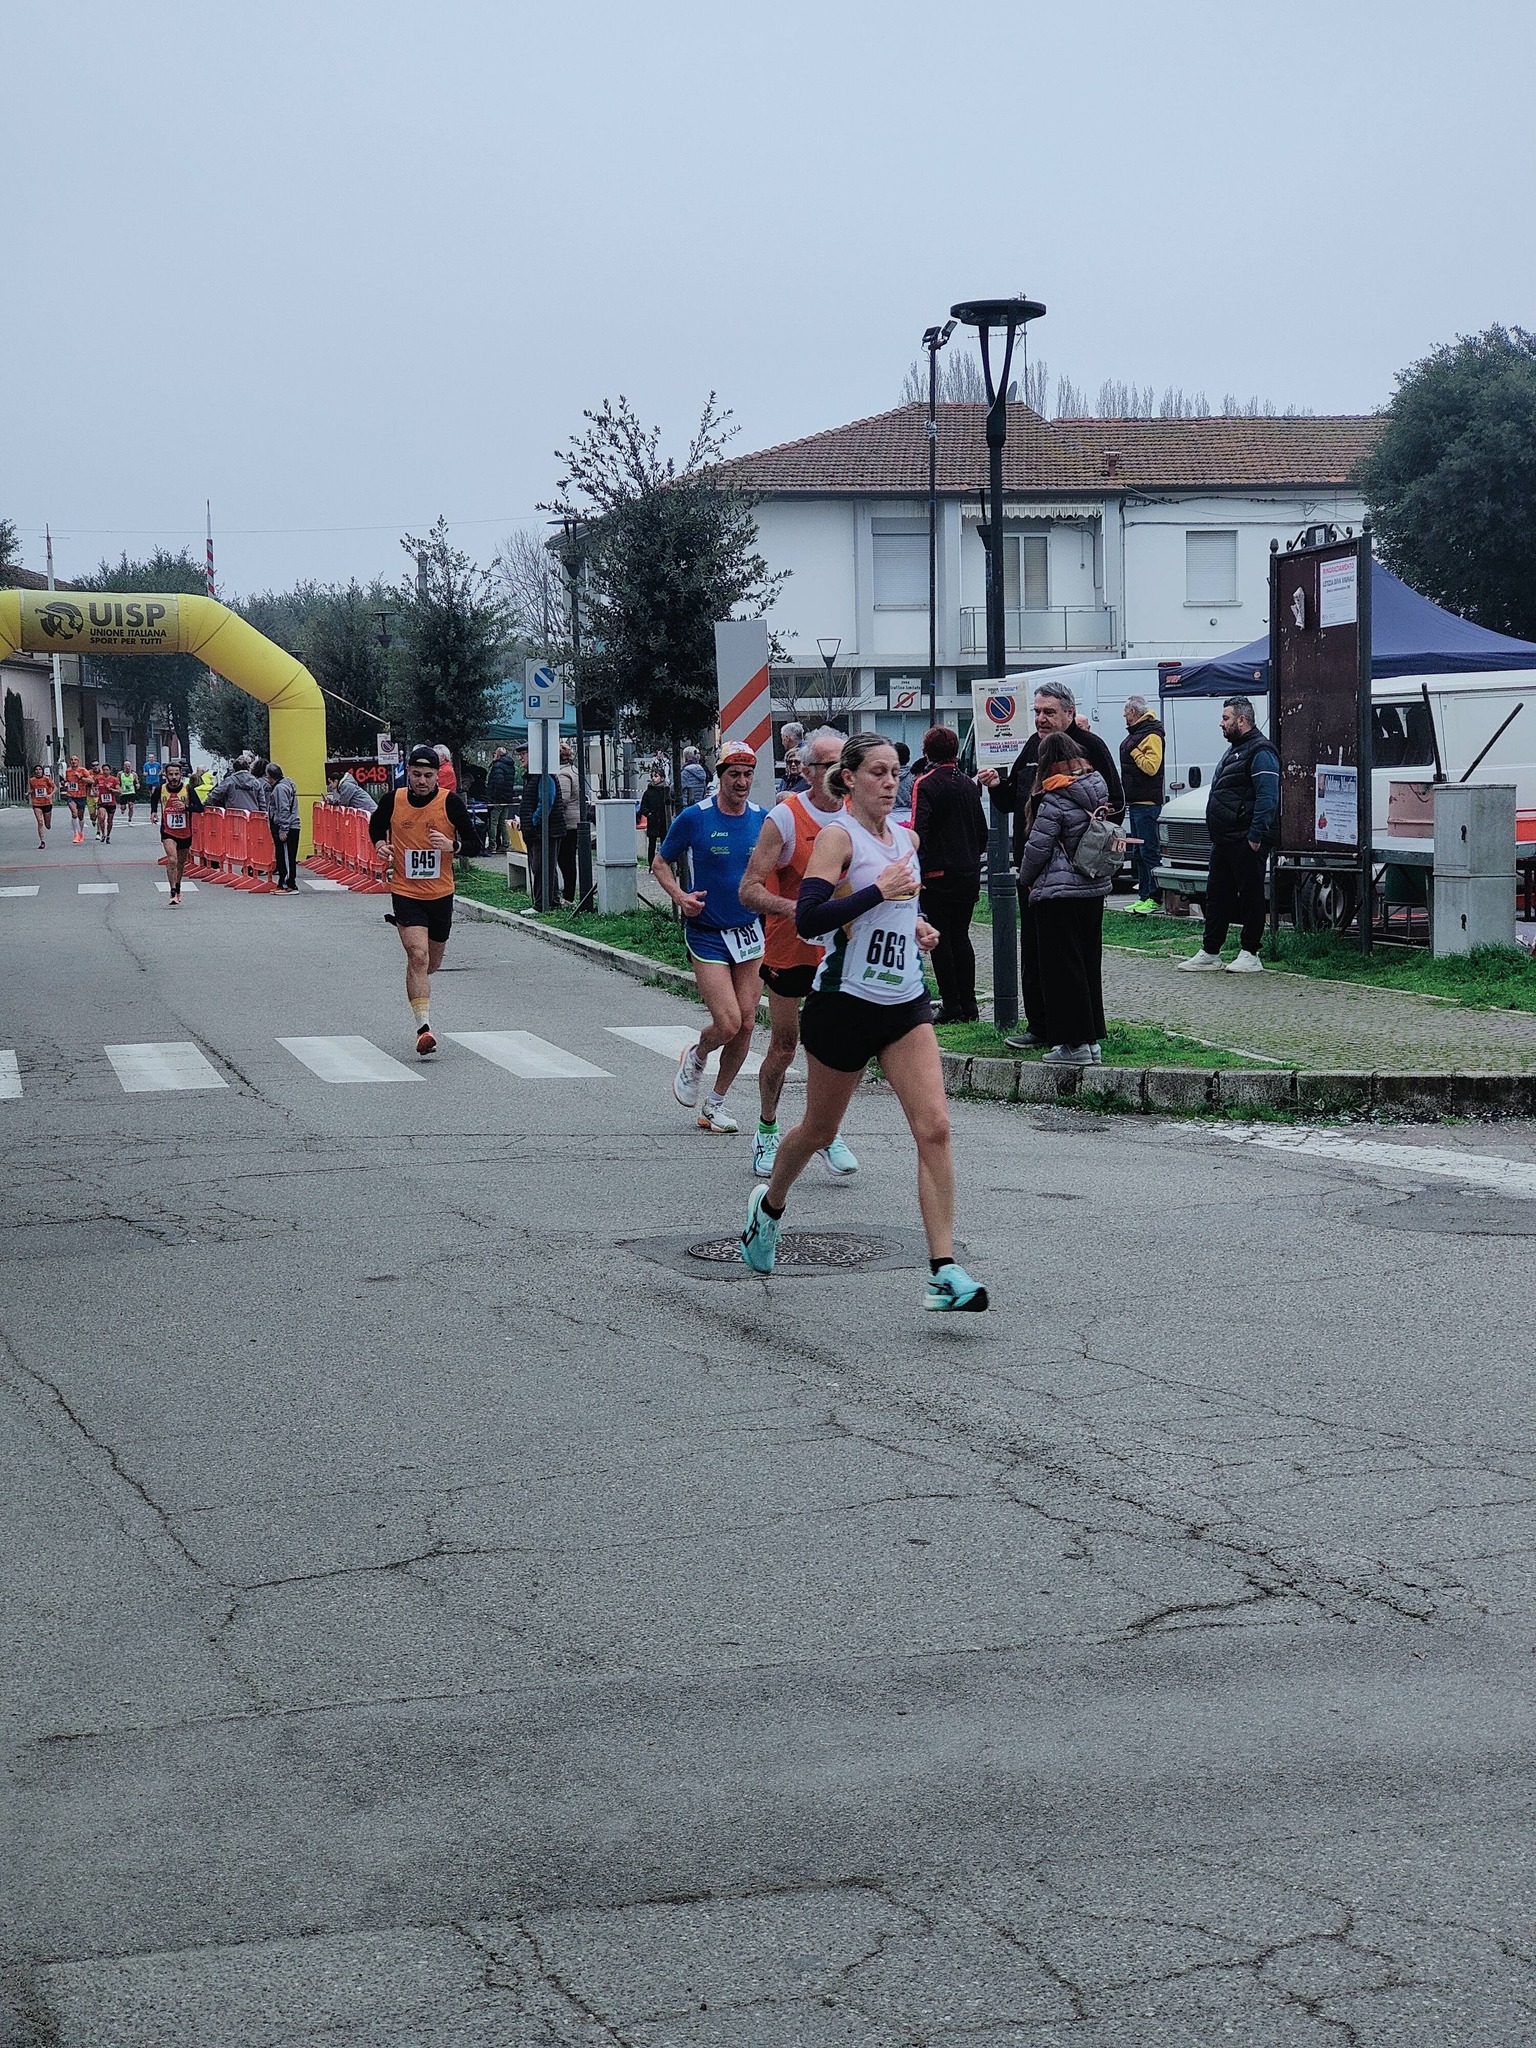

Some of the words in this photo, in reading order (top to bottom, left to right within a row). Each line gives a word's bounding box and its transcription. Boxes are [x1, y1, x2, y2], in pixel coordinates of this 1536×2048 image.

[89, 602, 166, 628] UISP
[90, 628, 124, 637] UNIONE
[127, 629, 167, 637] ITALIANA
[90, 637, 117, 645] SPORT
[530, 696, 539, 707] P
[171, 814, 184, 824] 735
[411, 850, 436, 869] 645
[866, 929, 906, 970] 663
